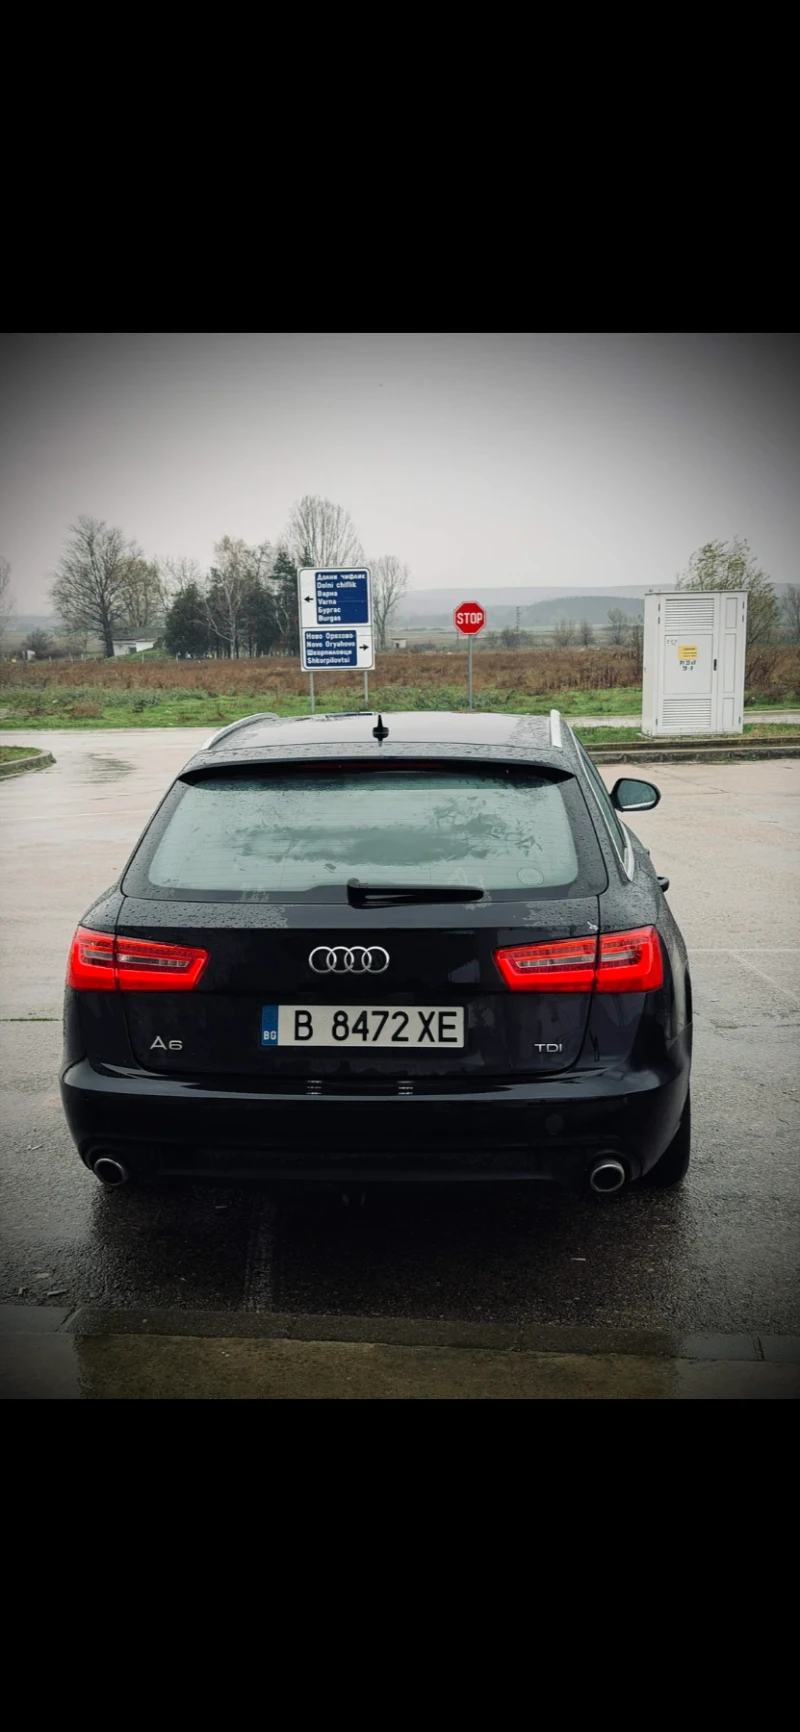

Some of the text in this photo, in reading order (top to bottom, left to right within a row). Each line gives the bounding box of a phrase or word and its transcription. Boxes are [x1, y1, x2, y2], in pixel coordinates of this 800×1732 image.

[457, 612, 483, 624] STOP
[325, 632, 353, 640] Оряхово
[294, 1010, 458, 1042] B 8472 XE
[263, 1031, 277, 1040] BG
[150, 1036, 183, 1050] A6
[534, 1043, 562, 1052] TDI
